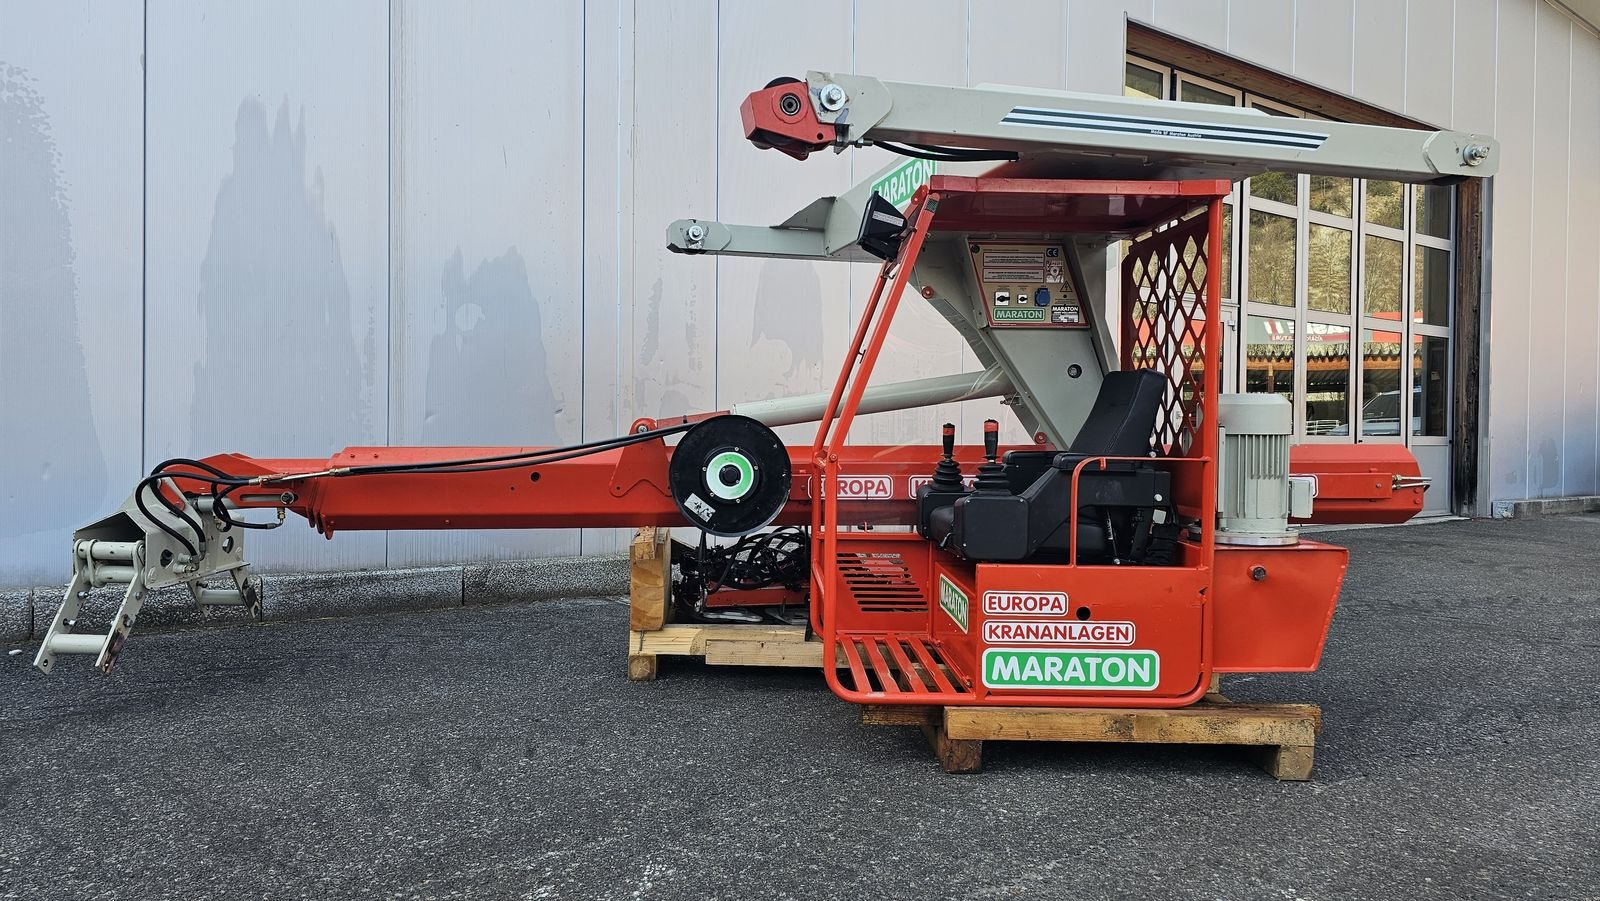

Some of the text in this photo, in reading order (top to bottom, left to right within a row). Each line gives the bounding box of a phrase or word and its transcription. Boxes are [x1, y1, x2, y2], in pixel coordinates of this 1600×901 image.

[876, 159, 932, 204] ARATON
[996, 310, 1043, 319] MARATON
[940, 580, 967, 627] MARATON
[987, 595, 1064, 612] EUROPA
[988, 624, 1130, 641] KRANANLAGEN
[991, 655, 1151, 683] MARATON
